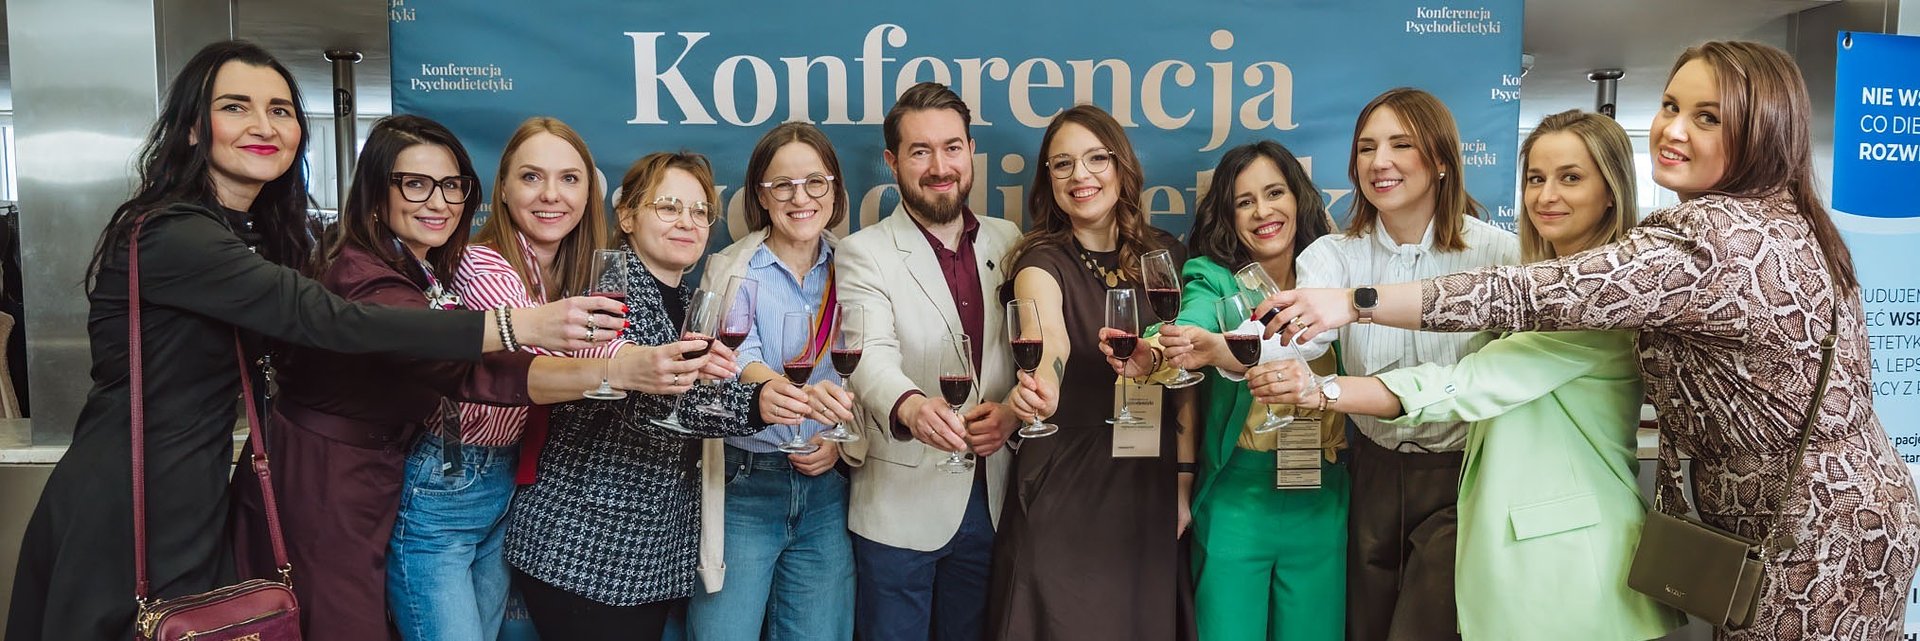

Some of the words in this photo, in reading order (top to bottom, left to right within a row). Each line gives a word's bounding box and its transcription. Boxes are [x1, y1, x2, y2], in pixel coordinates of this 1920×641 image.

[390, 8, 415, 22] tyki
[1417, 6, 1490, 20] Konferencja
[1405, 20, 1501, 35] Psychodietetyki
[421, 63, 502, 78] Konferencja
[411, 78, 513, 92] Psychodietetyki
[1502, 74, 1521, 86] Ko
[1491, 88, 1521, 102] Psyc
[1862, 86, 1894, 106] NIE
[1898, 88, 1920, 107] W
[1860, 114, 1888, 133] CO
[1893, 116, 1920, 134] DIE
[1859, 142, 1920, 162] ROZW
[1903, 380, 1913, 396] Z
